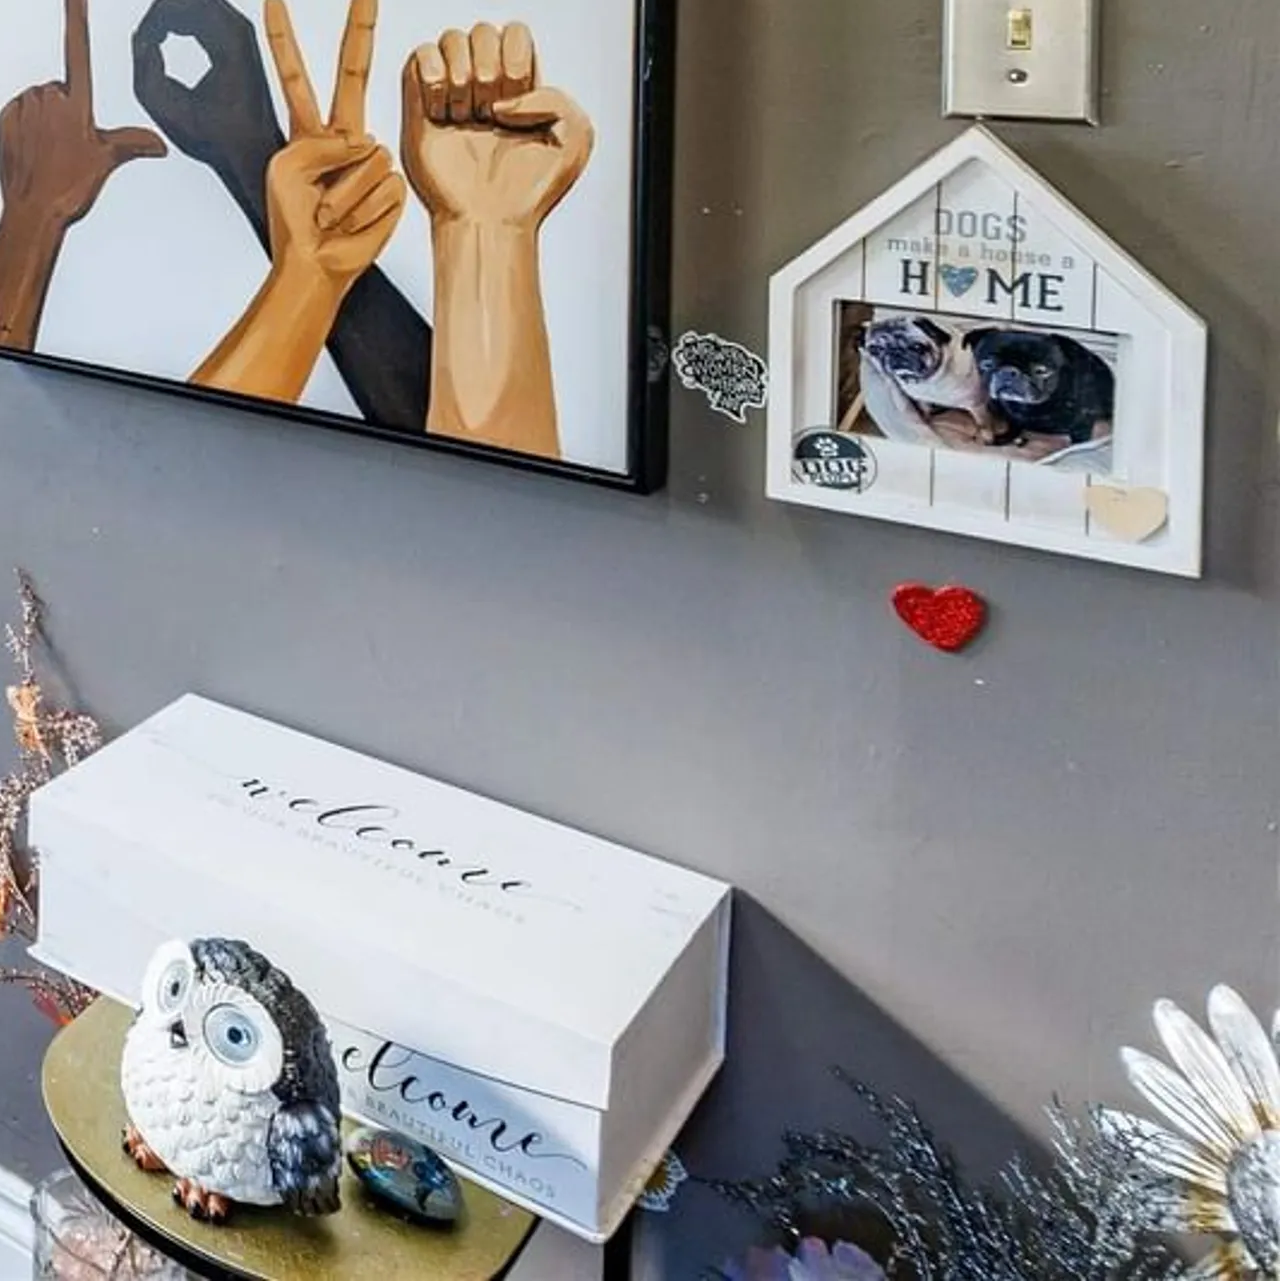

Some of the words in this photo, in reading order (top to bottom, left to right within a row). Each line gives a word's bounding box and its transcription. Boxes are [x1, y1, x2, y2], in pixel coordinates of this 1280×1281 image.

[886, 235, 949, 258] make
[959, 243, 970, 258] a
[980, 243, 1051, 267] house
[1061, 255, 1075, 270] a
[935, 208, 1028, 243] DOGS
[900, 258, 1065, 312] HME
[240, 777, 532, 891] welcome
[343, 1041, 588, 1171] elcome
[365, 1096, 476, 1160] BEAUTIFUL
[483, 1156, 558, 1200] CHAOS
